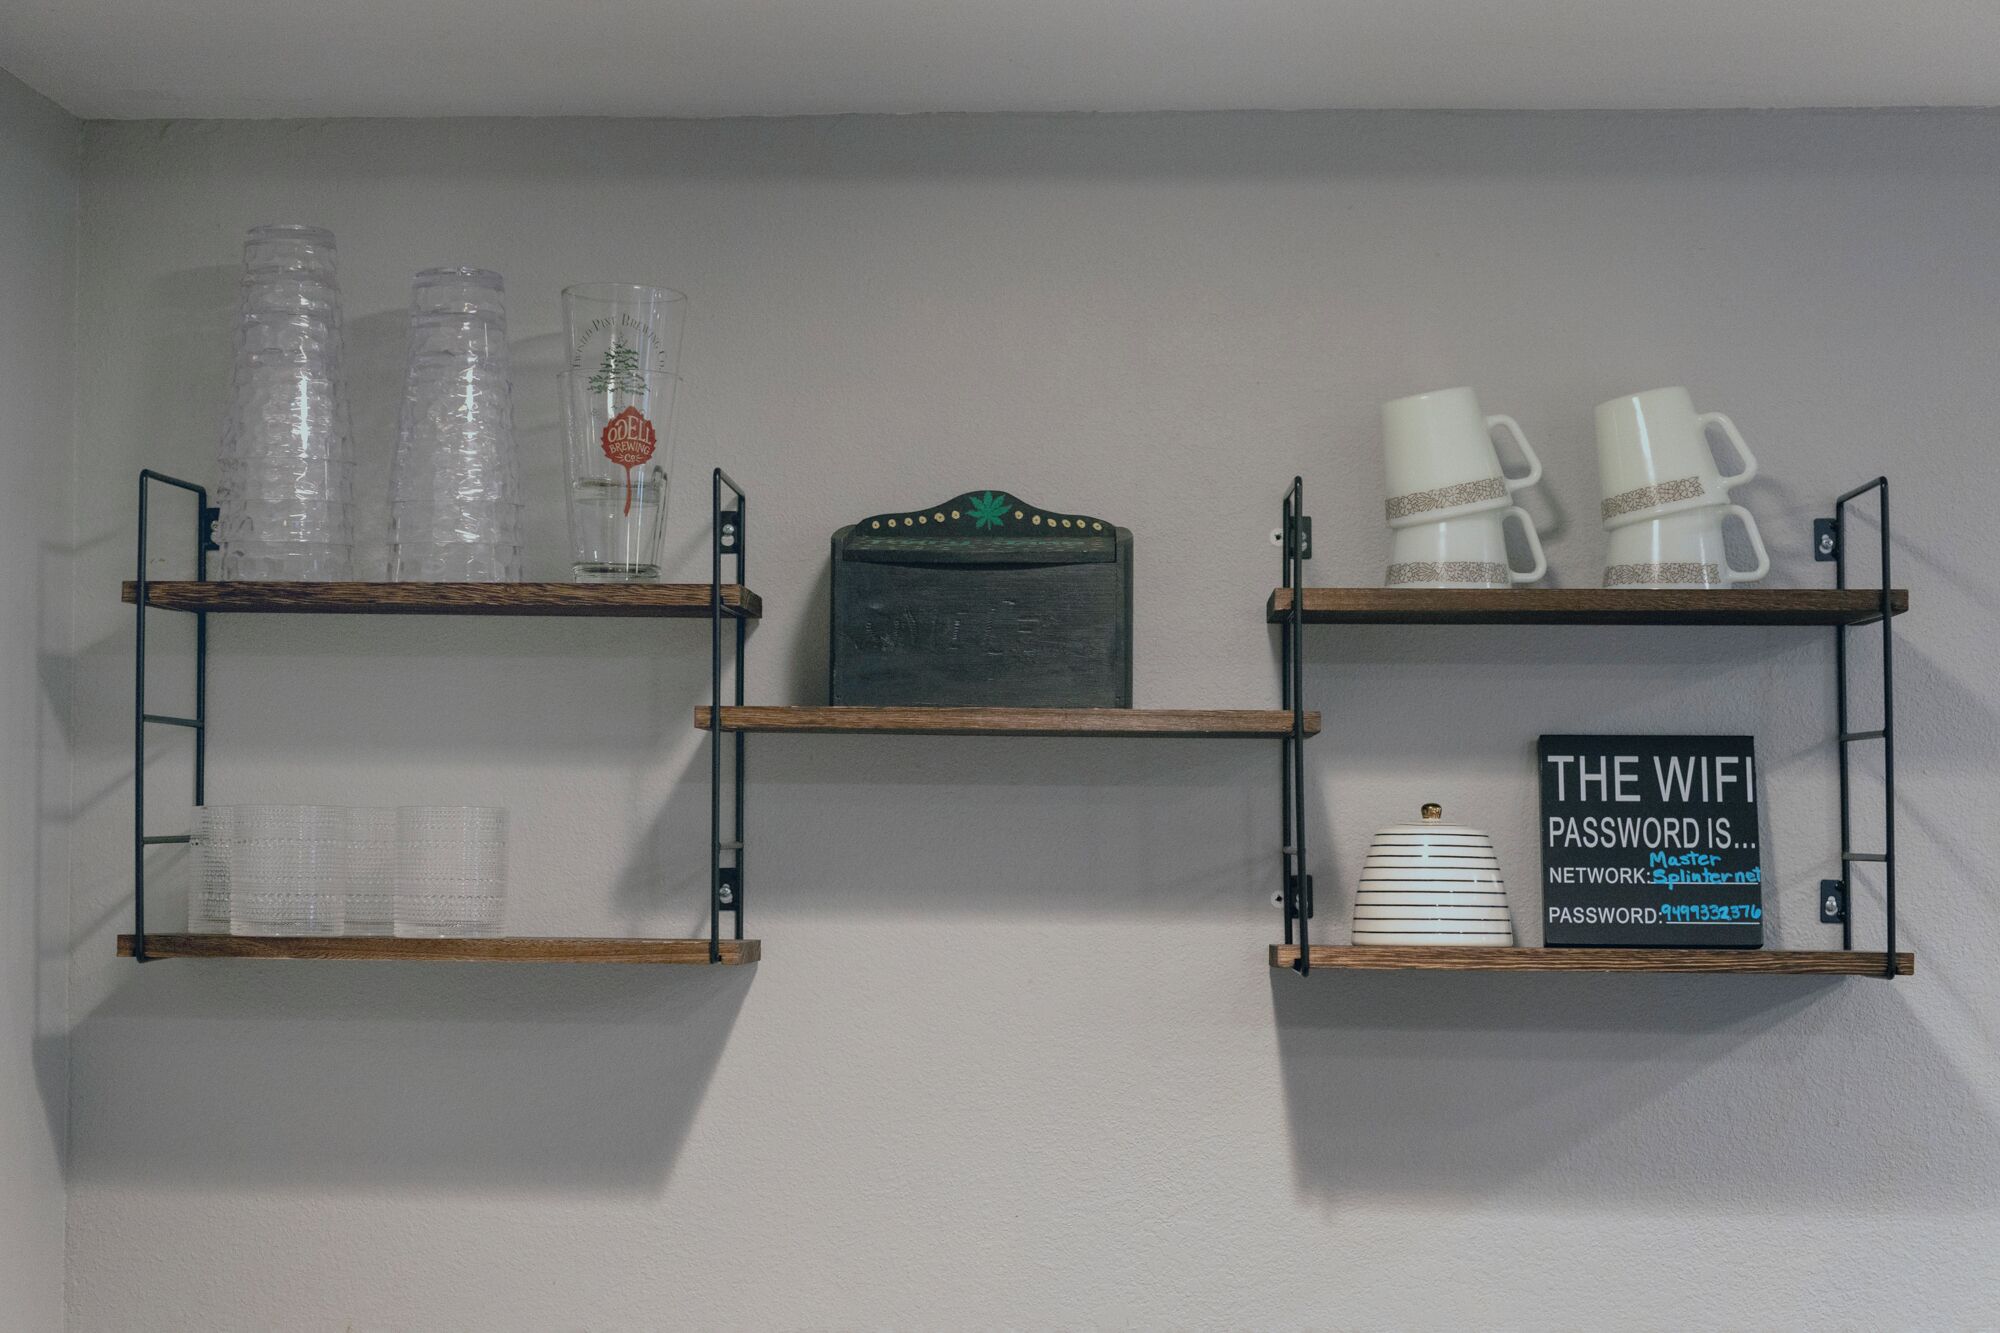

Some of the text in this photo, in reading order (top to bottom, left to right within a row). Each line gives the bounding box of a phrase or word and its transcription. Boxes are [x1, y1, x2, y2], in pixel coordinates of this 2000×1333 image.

[608, 416, 651, 445] ODELL
[609, 442, 650, 455] BREWING
[1548, 755, 1754, 803] THE WIFI
[1549, 816, 1757, 849] PASSWORD IS...
[1649, 850, 1722, 867] Master
[1549, 867, 1651, 884] NETWORK:
[1549, 907, 1663, 924] PASSWORD:
[1660, 903, 1761, 922] 9499332376
